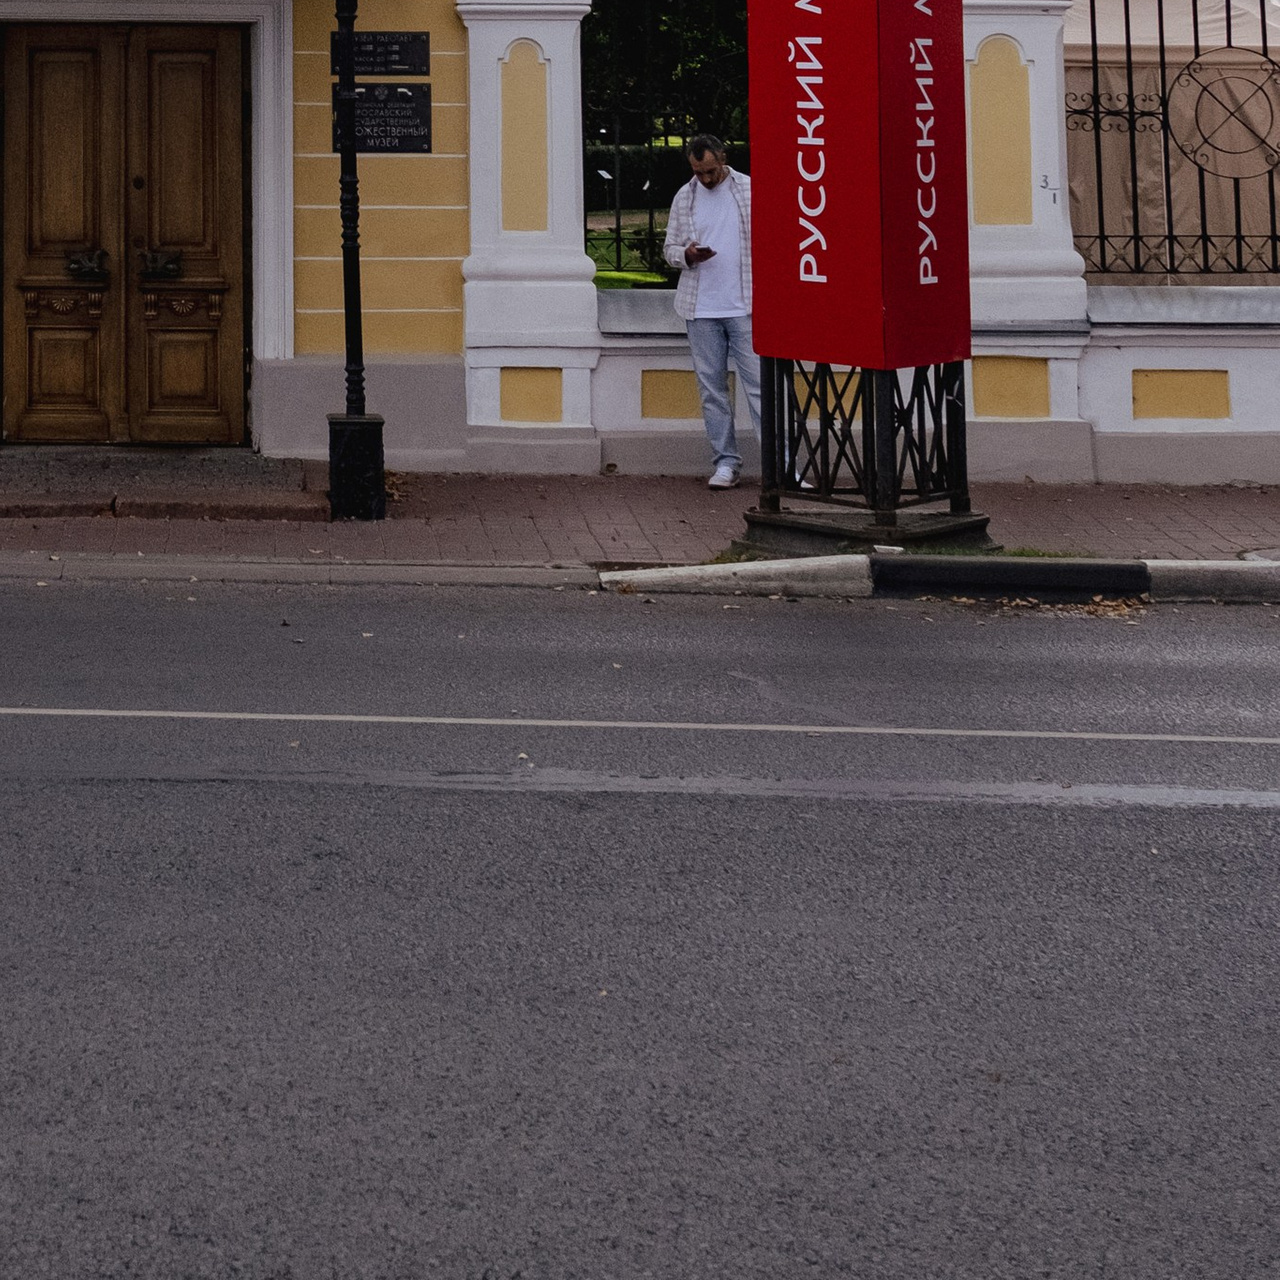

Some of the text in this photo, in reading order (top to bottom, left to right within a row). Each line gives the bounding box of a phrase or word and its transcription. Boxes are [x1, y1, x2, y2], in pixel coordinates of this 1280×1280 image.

[354, 108, 413, 117] РОСЛАВСКИЙ
[367, 136, 399, 147] МУЗЕЙ
[787, 36, 827, 284] РУССКИЙ
[909, 37, 938, 285] РУССКИЙ
